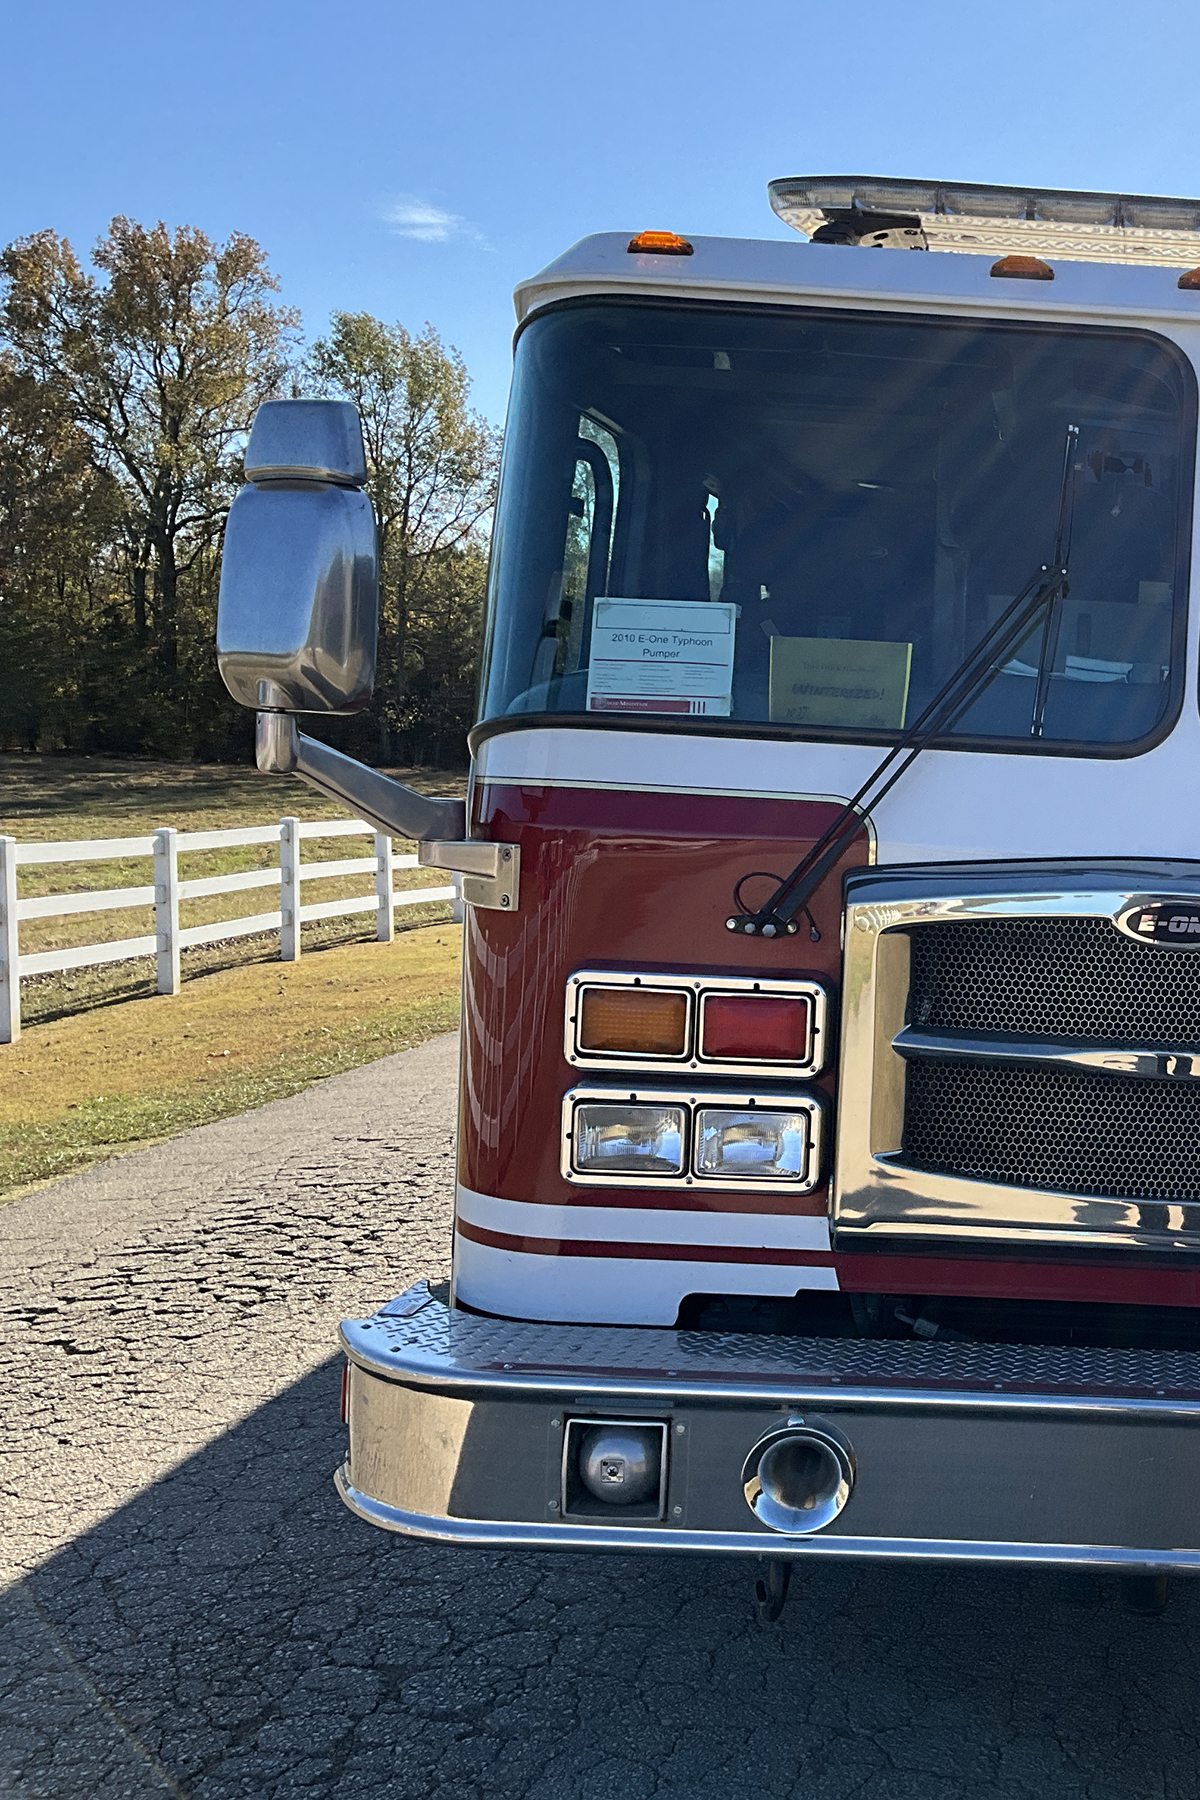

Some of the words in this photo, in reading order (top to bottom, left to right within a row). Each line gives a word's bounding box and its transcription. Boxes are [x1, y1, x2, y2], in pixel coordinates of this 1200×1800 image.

[611, 633, 636, 643] 2010
[638, 634, 669, 644] E-One
[672, 635, 713, 647] Typhoon
[642, 648, 681, 659] Pumper
